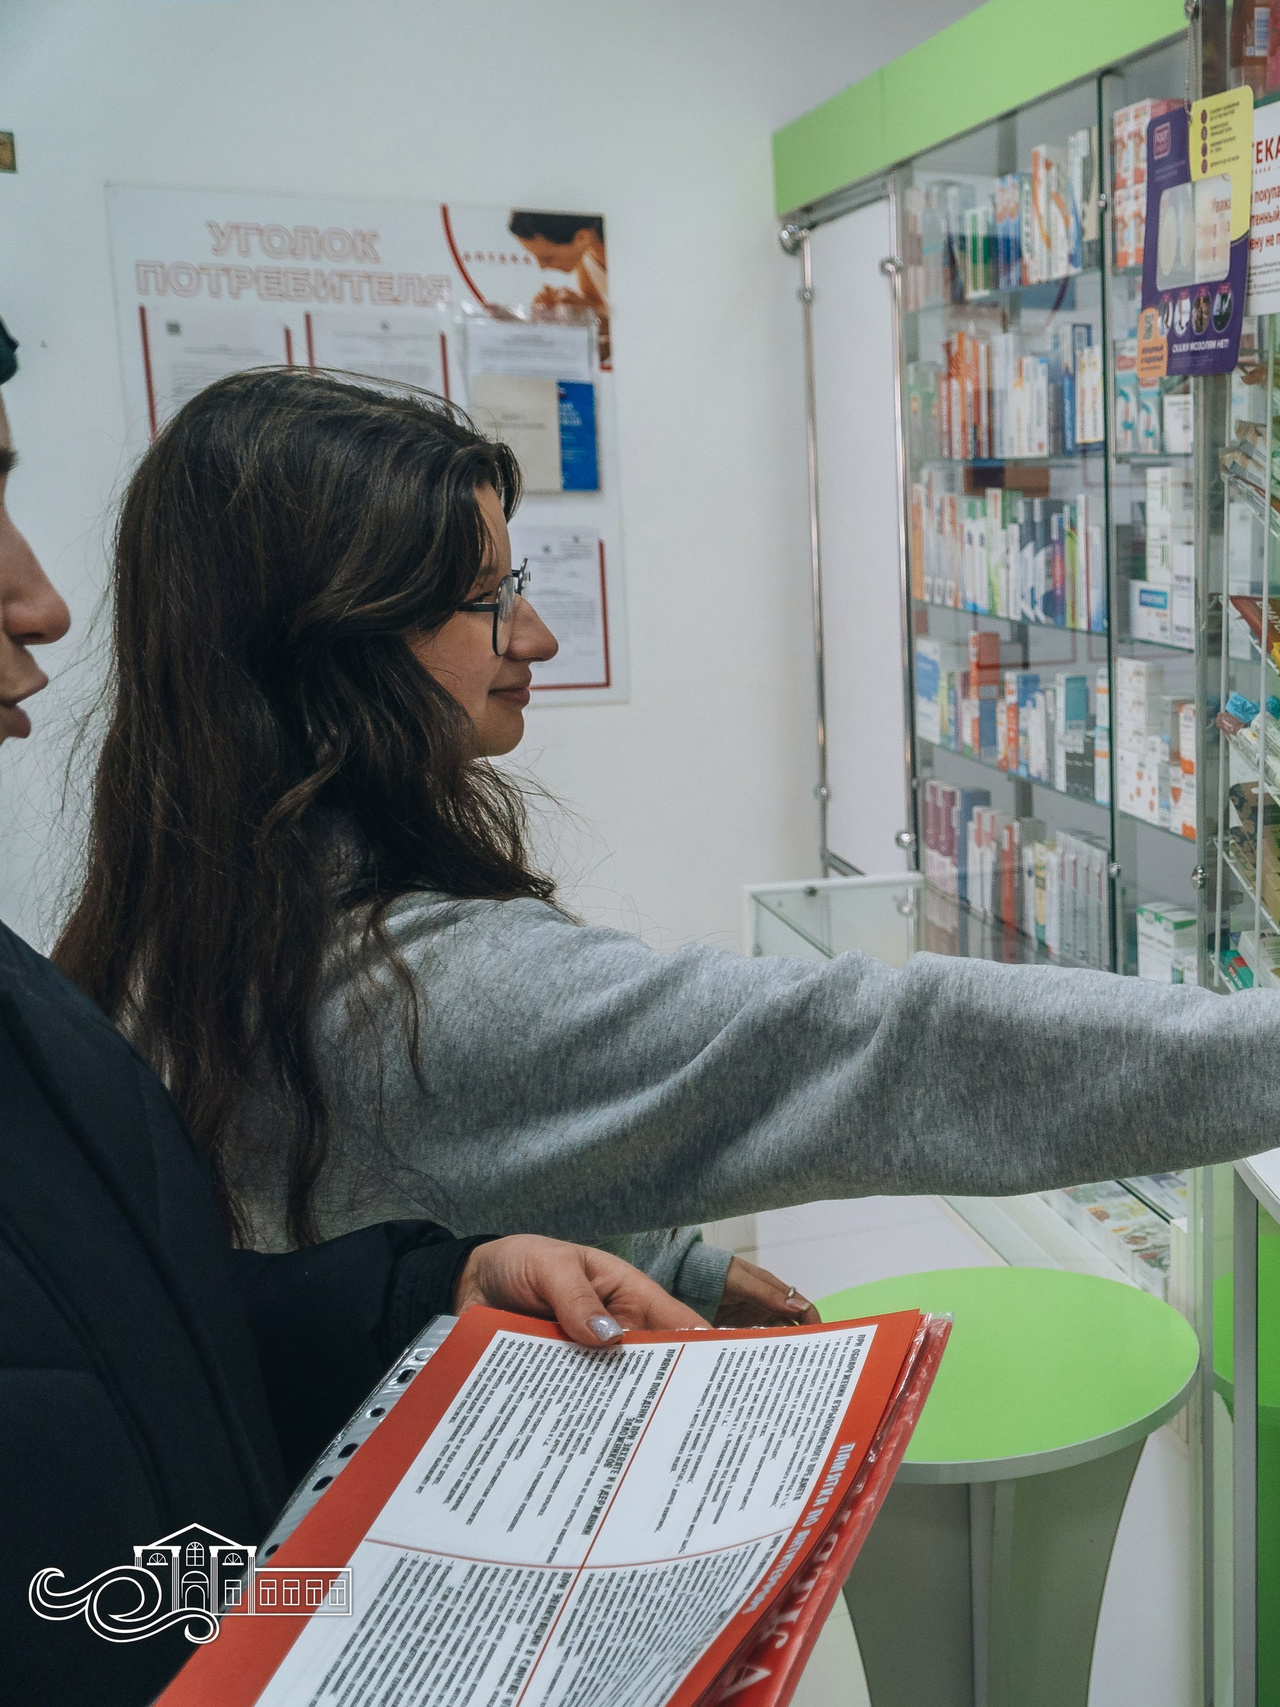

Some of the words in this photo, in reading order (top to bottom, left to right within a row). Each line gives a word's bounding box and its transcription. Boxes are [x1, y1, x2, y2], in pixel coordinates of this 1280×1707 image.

[206, 219, 381, 263] УГОЛОК
[1265, 234, 1274, 247] не
[134, 259, 453, 306] ПОТРЕБИТЕЛЯ
[853, 1334, 866, 1346] ПРИ
[653, 1348, 676, 1380] ПРАВИЛА
[834, 1348, 861, 1397] ОБНАРУЖЕНИИ
[632, 1382, 660, 1423] ПОВЕДЕНИЯ
[601, 1417, 635, 1468] ЗАЛОЖНИКОВ
[626, 1425, 641, 1439] ПРИ
[809, 1400, 842, 1461] ВЗРЫВООПАСНОГО
[609, 1442, 632, 1474] ЗАХВАТЕ
[813, 1442, 855, 1507] ПАМЯТКА
[791, 1463, 816, 1501] ПРЕДМЕТА
[580, 1484, 613, 1535] УДЕРЖАНИИ
[802, 1508, 824, 1527] ПО
[555, 1572, 575, 1589] ПРИ
[528, 1592, 565, 1647] ЭВАКУАЦИИ
